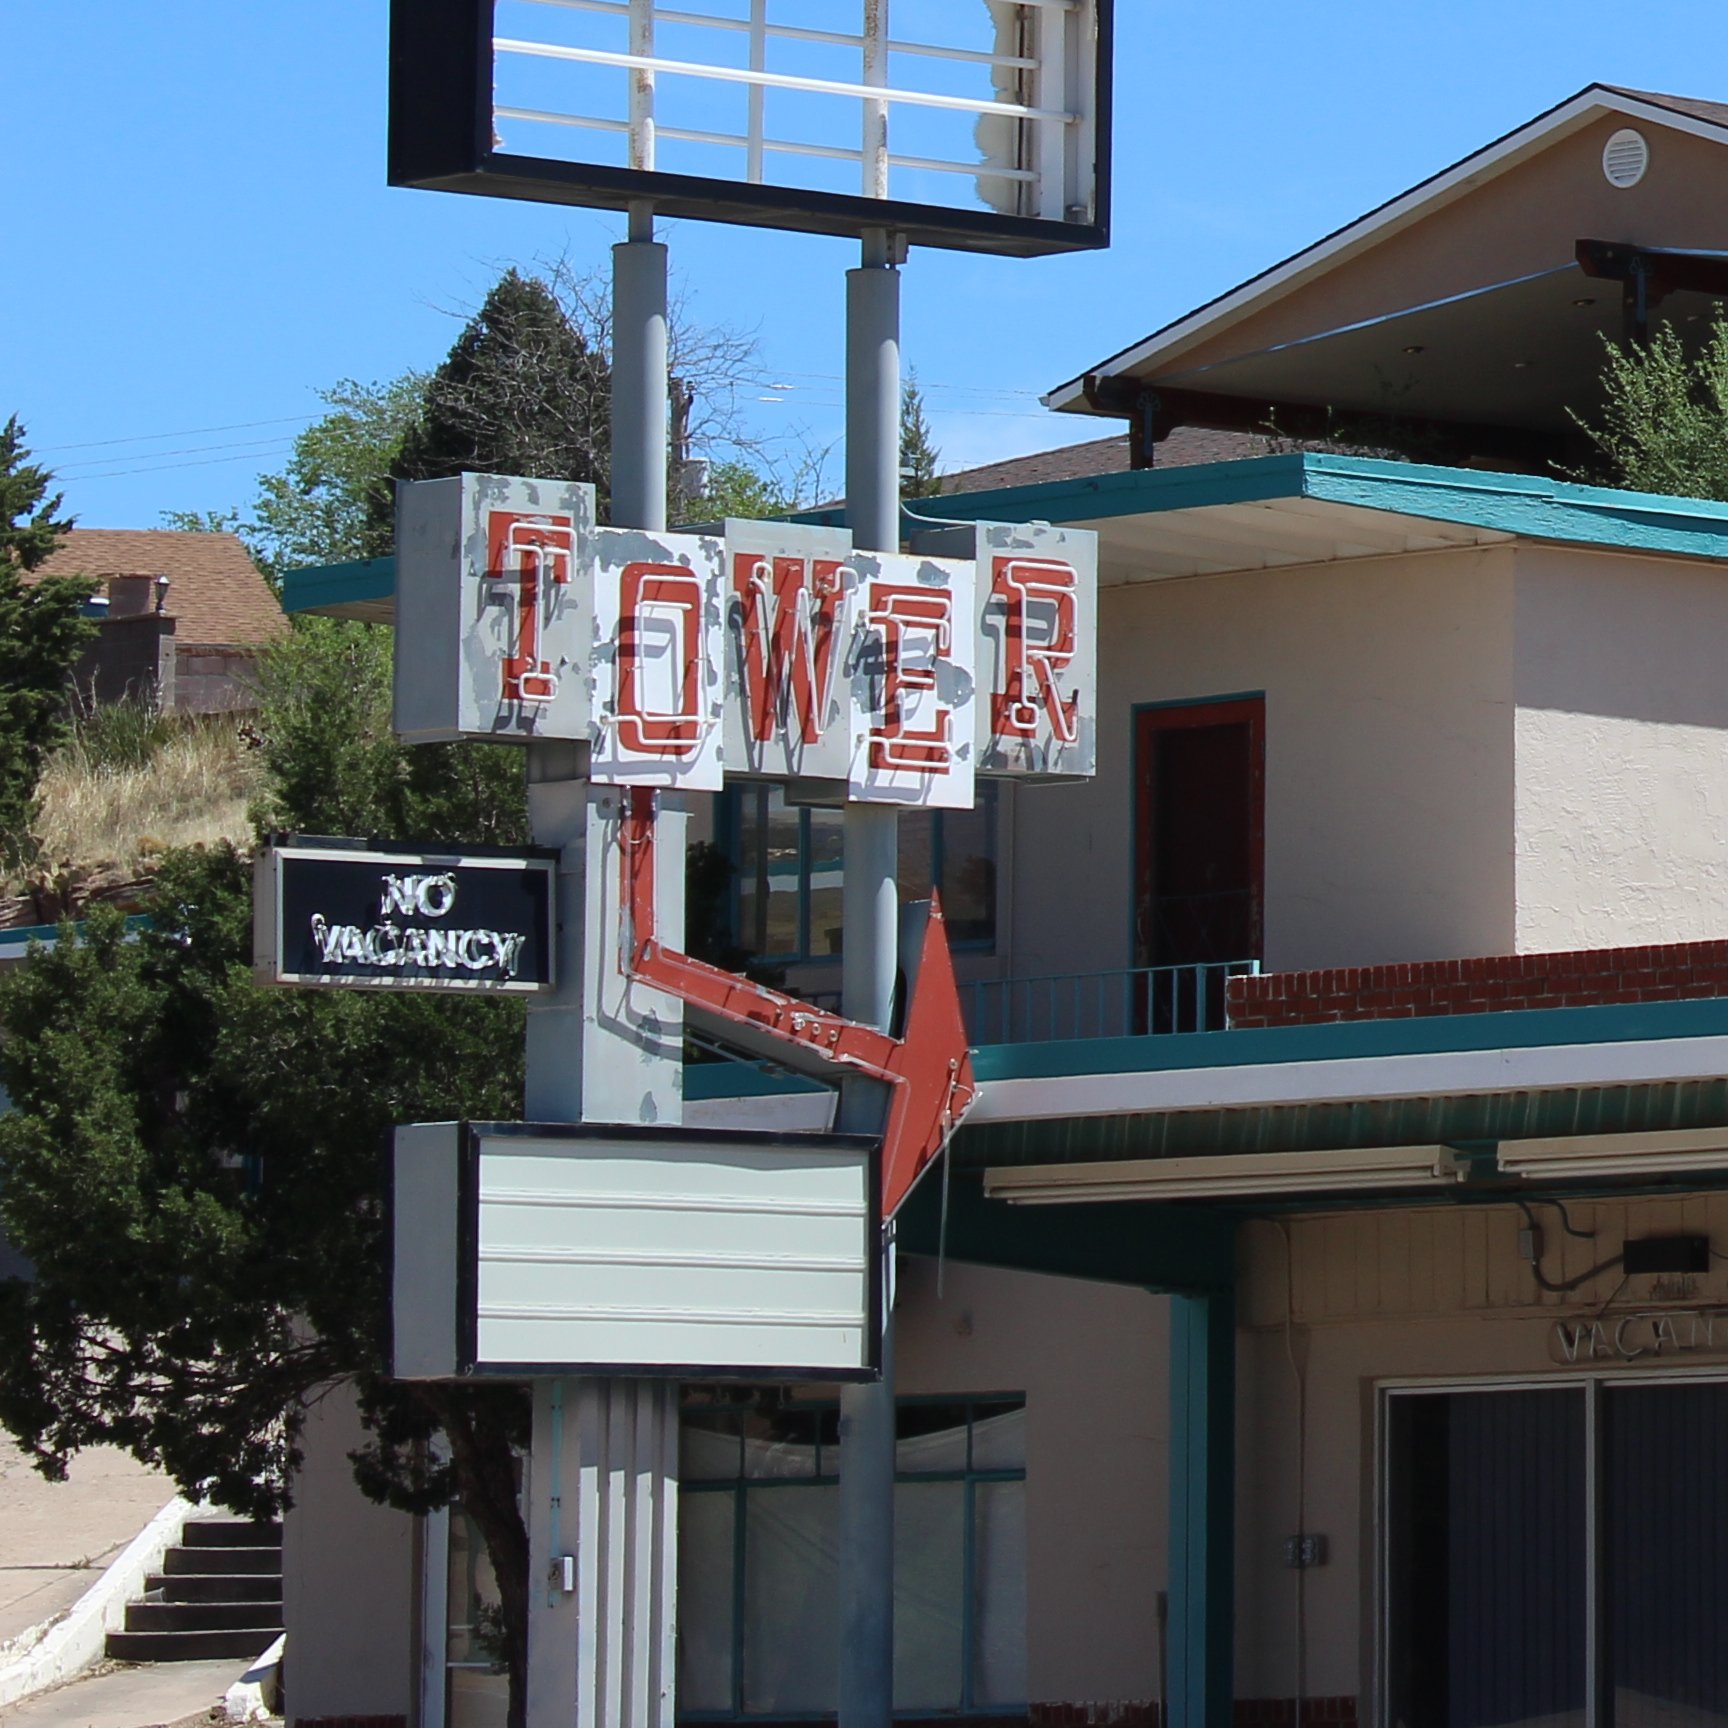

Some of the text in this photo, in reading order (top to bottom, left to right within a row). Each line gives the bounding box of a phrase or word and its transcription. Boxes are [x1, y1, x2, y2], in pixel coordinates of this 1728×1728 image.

[488, 511, 1080, 775] TOWER
[381, 872, 457, 918] NO
[312, 915, 526, 977] VACANCY
